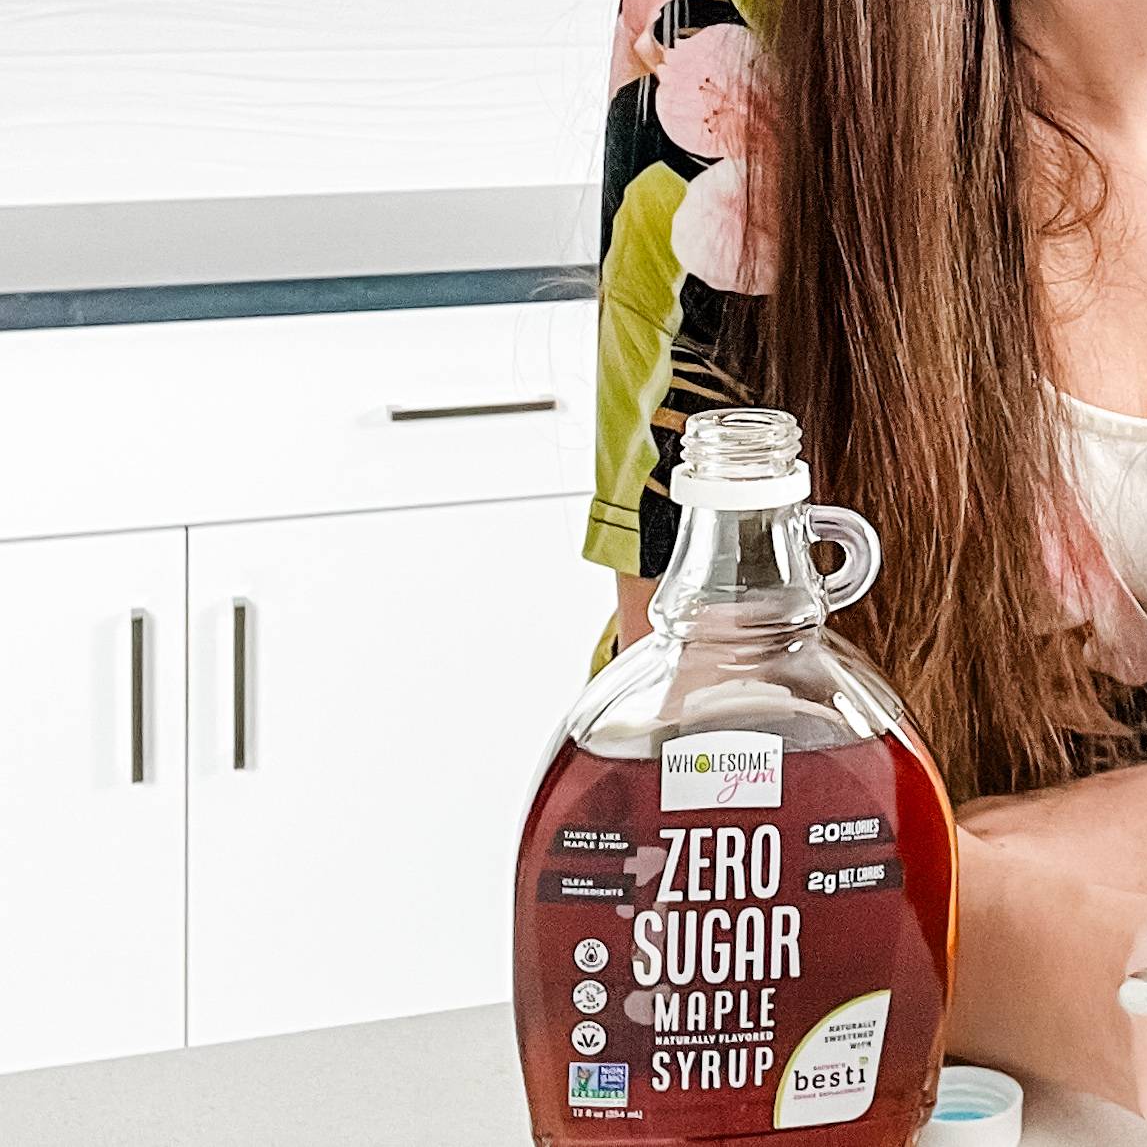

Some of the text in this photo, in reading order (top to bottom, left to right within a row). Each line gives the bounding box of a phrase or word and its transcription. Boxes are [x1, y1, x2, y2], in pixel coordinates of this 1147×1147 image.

[667, 751, 771, 773] WHOLESOME
[716, 768, 775, 804] yum
[563, 840, 629, 850] MAPLE SYRUP
[808, 823, 840, 844] 20
[840, 818, 880, 836] CALORIES
[656, 823, 781, 902] ZERO
[807, 871, 837, 894] 2g
[839, 868, 856, 883] NET
[856, 864, 885, 882] CARBS
[632, 905, 801, 986] SUGAR
[654, 987, 776, 1032] MAPLE
[655, 1030, 774, 1046] NATURALLY FLAVORED
[651, 1046, 774, 1092] SYRUP
[794, 1058, 867, 1092] besti
